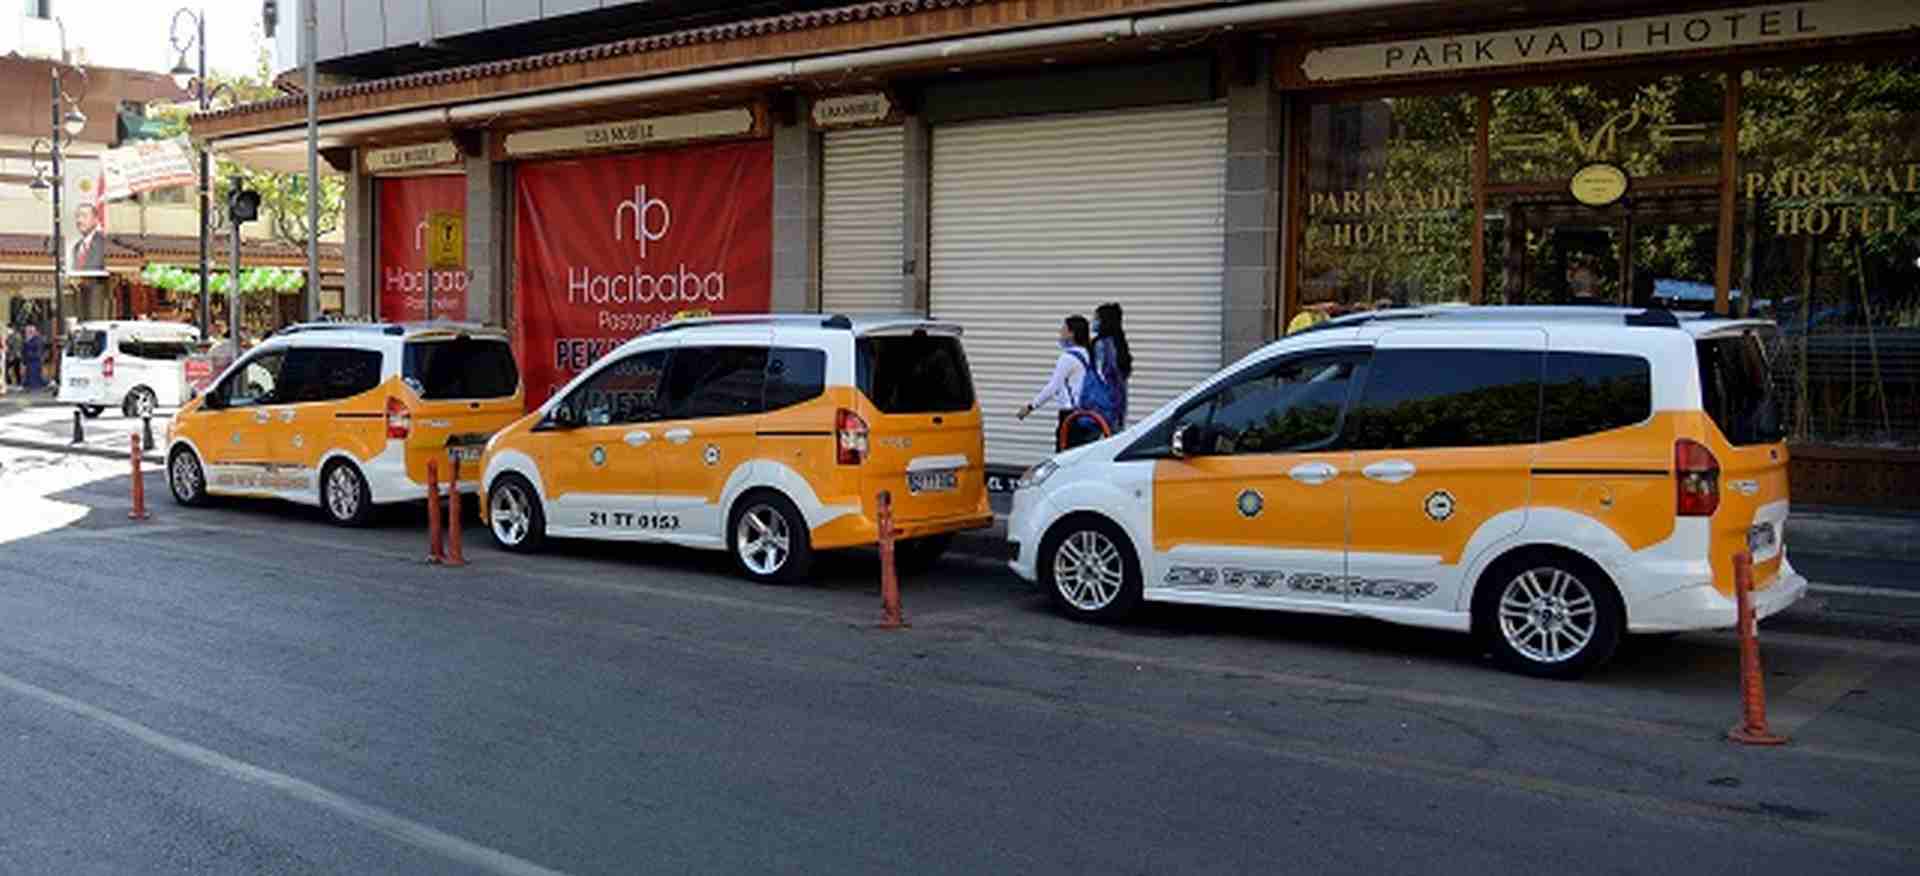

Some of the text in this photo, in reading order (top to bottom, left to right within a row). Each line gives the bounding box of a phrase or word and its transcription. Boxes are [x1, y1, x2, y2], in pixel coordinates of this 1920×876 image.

[1384, 9, 1818, 69] PARK VADI HOTEL
[1744, 168, 1841, 199] PARK
[1309, 189, 1384, 216] PARK
[1775, 206, 1906, 236] HOTEL
[589, 511, 607, 527] 21
[613, 512, 634, 527] TT
